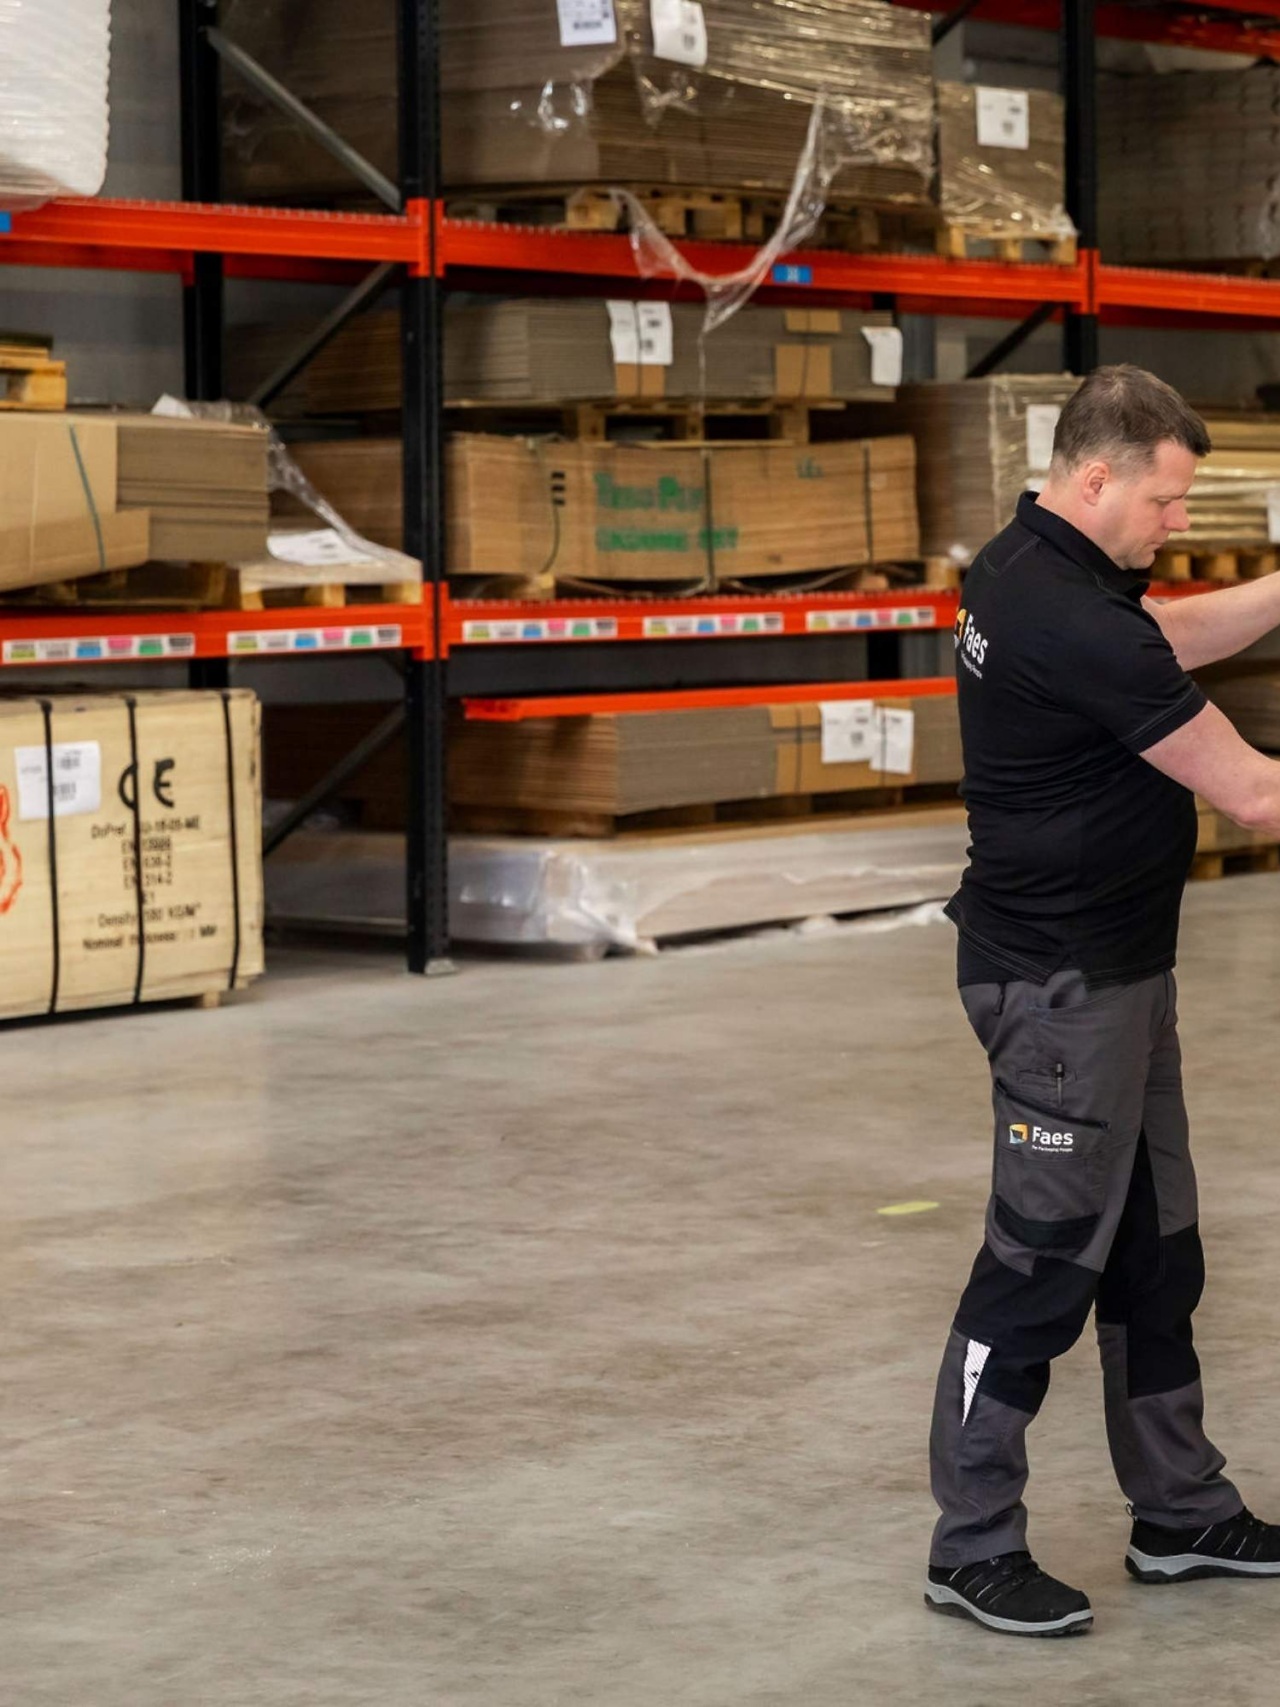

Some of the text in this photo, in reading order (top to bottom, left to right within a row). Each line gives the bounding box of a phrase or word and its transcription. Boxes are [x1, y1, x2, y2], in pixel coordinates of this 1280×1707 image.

[963, 613, 989, 665] Faes
[118, 758, 175, 811] CE
[1032, 1126, 1074, 1145] Faes
